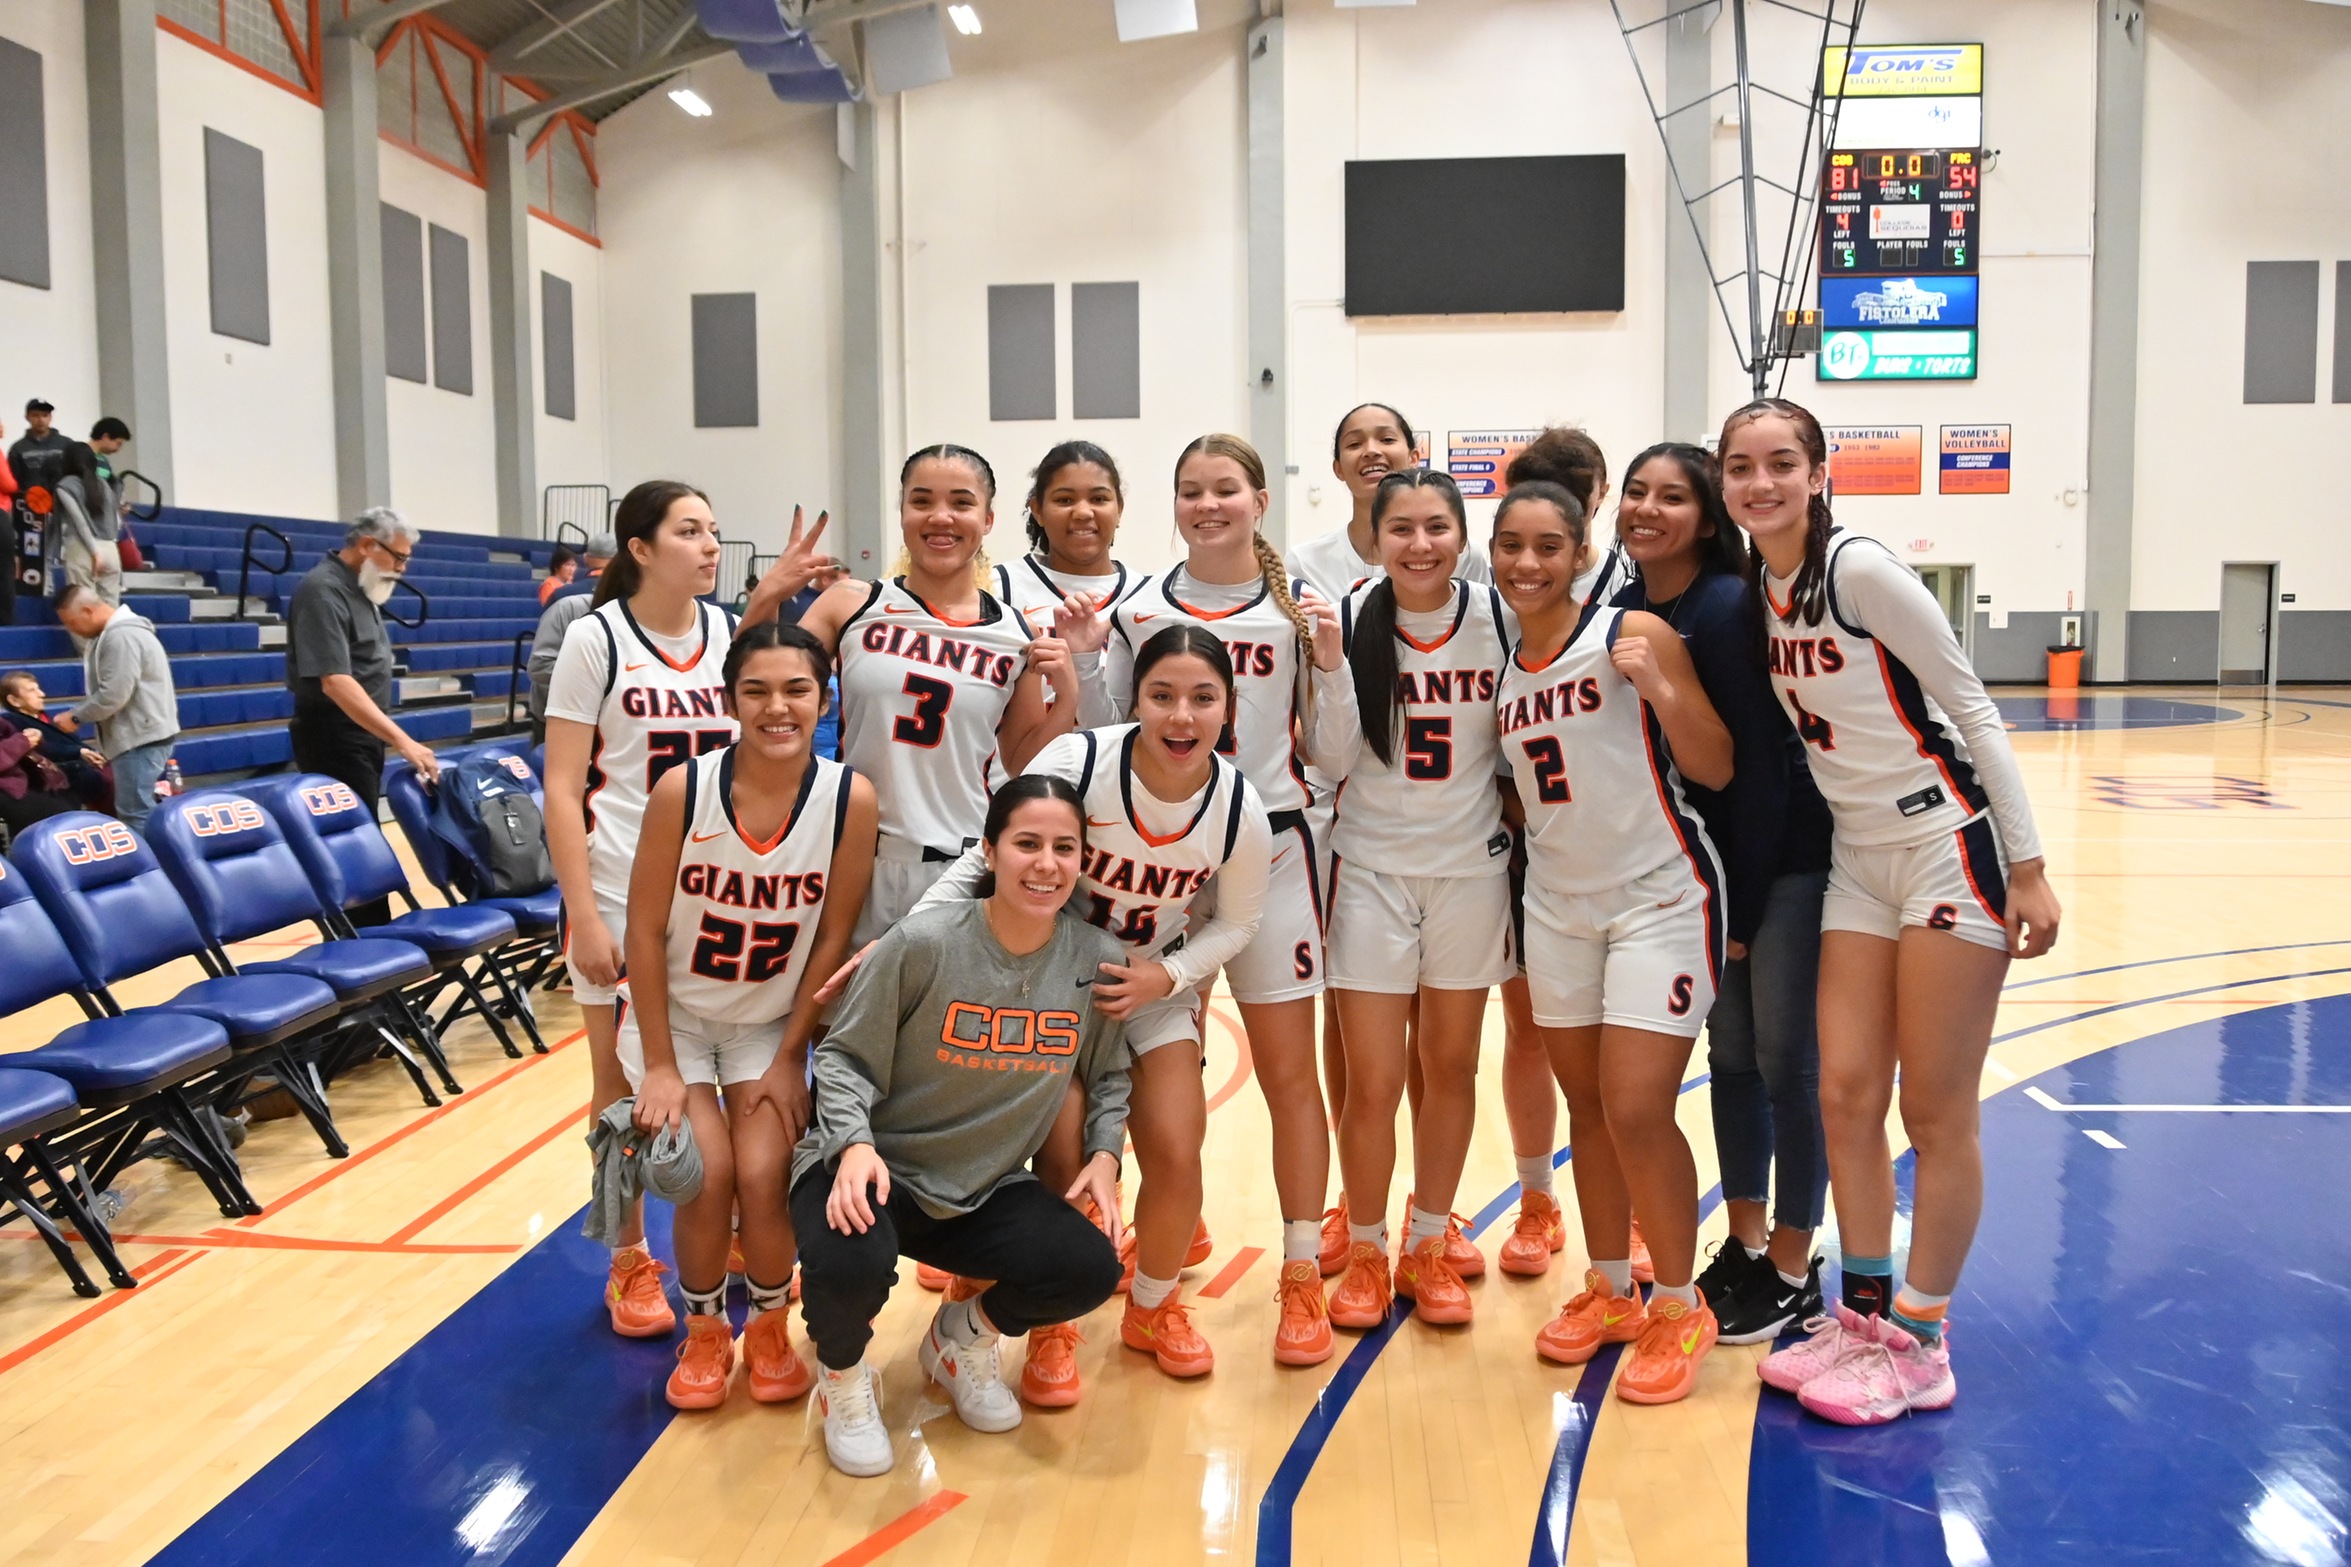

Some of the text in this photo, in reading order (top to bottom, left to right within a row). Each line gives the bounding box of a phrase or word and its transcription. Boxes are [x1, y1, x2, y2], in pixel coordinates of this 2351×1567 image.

[1845, 49, 1962, 75] TOM'S
[1832, 167, 1858, 190] 81
[1950, 166, 1976, 188] 54
[1838, 192, 1861, 201] BONUS
[1880, 186, 1906, 195] PERIOD
[1909, 183, 1919, 200] 4
[1939, 191, 1963, 199] BONUS
[1826, 205, 1860, 213] TIMEOUTS
[1940, 204, 1975, 212] TIMEOUTS
[1837, 213, 1849, 230] 4
[1952, 211, 1964, 229] 0
[1833, 231, 1849, 239] LEFT
[1949, 229, 1965, 237] LEFT
[1833, 241, 1855, 249] FOULS
[1877, 240, 1928, 249] PLAYER FOULS
[1943, 240, 1965, 248] FOULS
[1844, 249, 1854, 267] 5
[1955, 248, 1964, 266] 5
[1462, 435, 1509, 443] WOMEN'S
[1838, 430, 1901, 439] BASKETBALL
[1950, 430, 1998, 438] WOMEN'S
[1945, 439, 2006, 448] VOLLEYBALL
[1451, 463, 1468, 471] STATE
[862, 623, 1014, 688] GIANTS
[1769, 636, 1845, 679] ANTS
[1397, 669, 1495, 705] ANTS
[622, 686, 729, 718] GIANT
[892, 672, 954, 749] 3
[1785, 688, 1837, 752] 4
[1405, 716, 1453, 781] 5
[1521, 734, 1573, 805] 2
[300, 783, 358, 815] COS
[1929, 792, 1938, 801] S
[182, 799, 265, 837] COS
[54, 821, 137, 865] COS
[680, 863, 825, 910] GIANTS
[1084, 890, 1157, 947] 14
[690, 911, 801, 983] 22
[1294, 940, 1314, 981] S
[1668, 973, 1694, 1017] S
[940, 1000, 1080, 1056] COS
